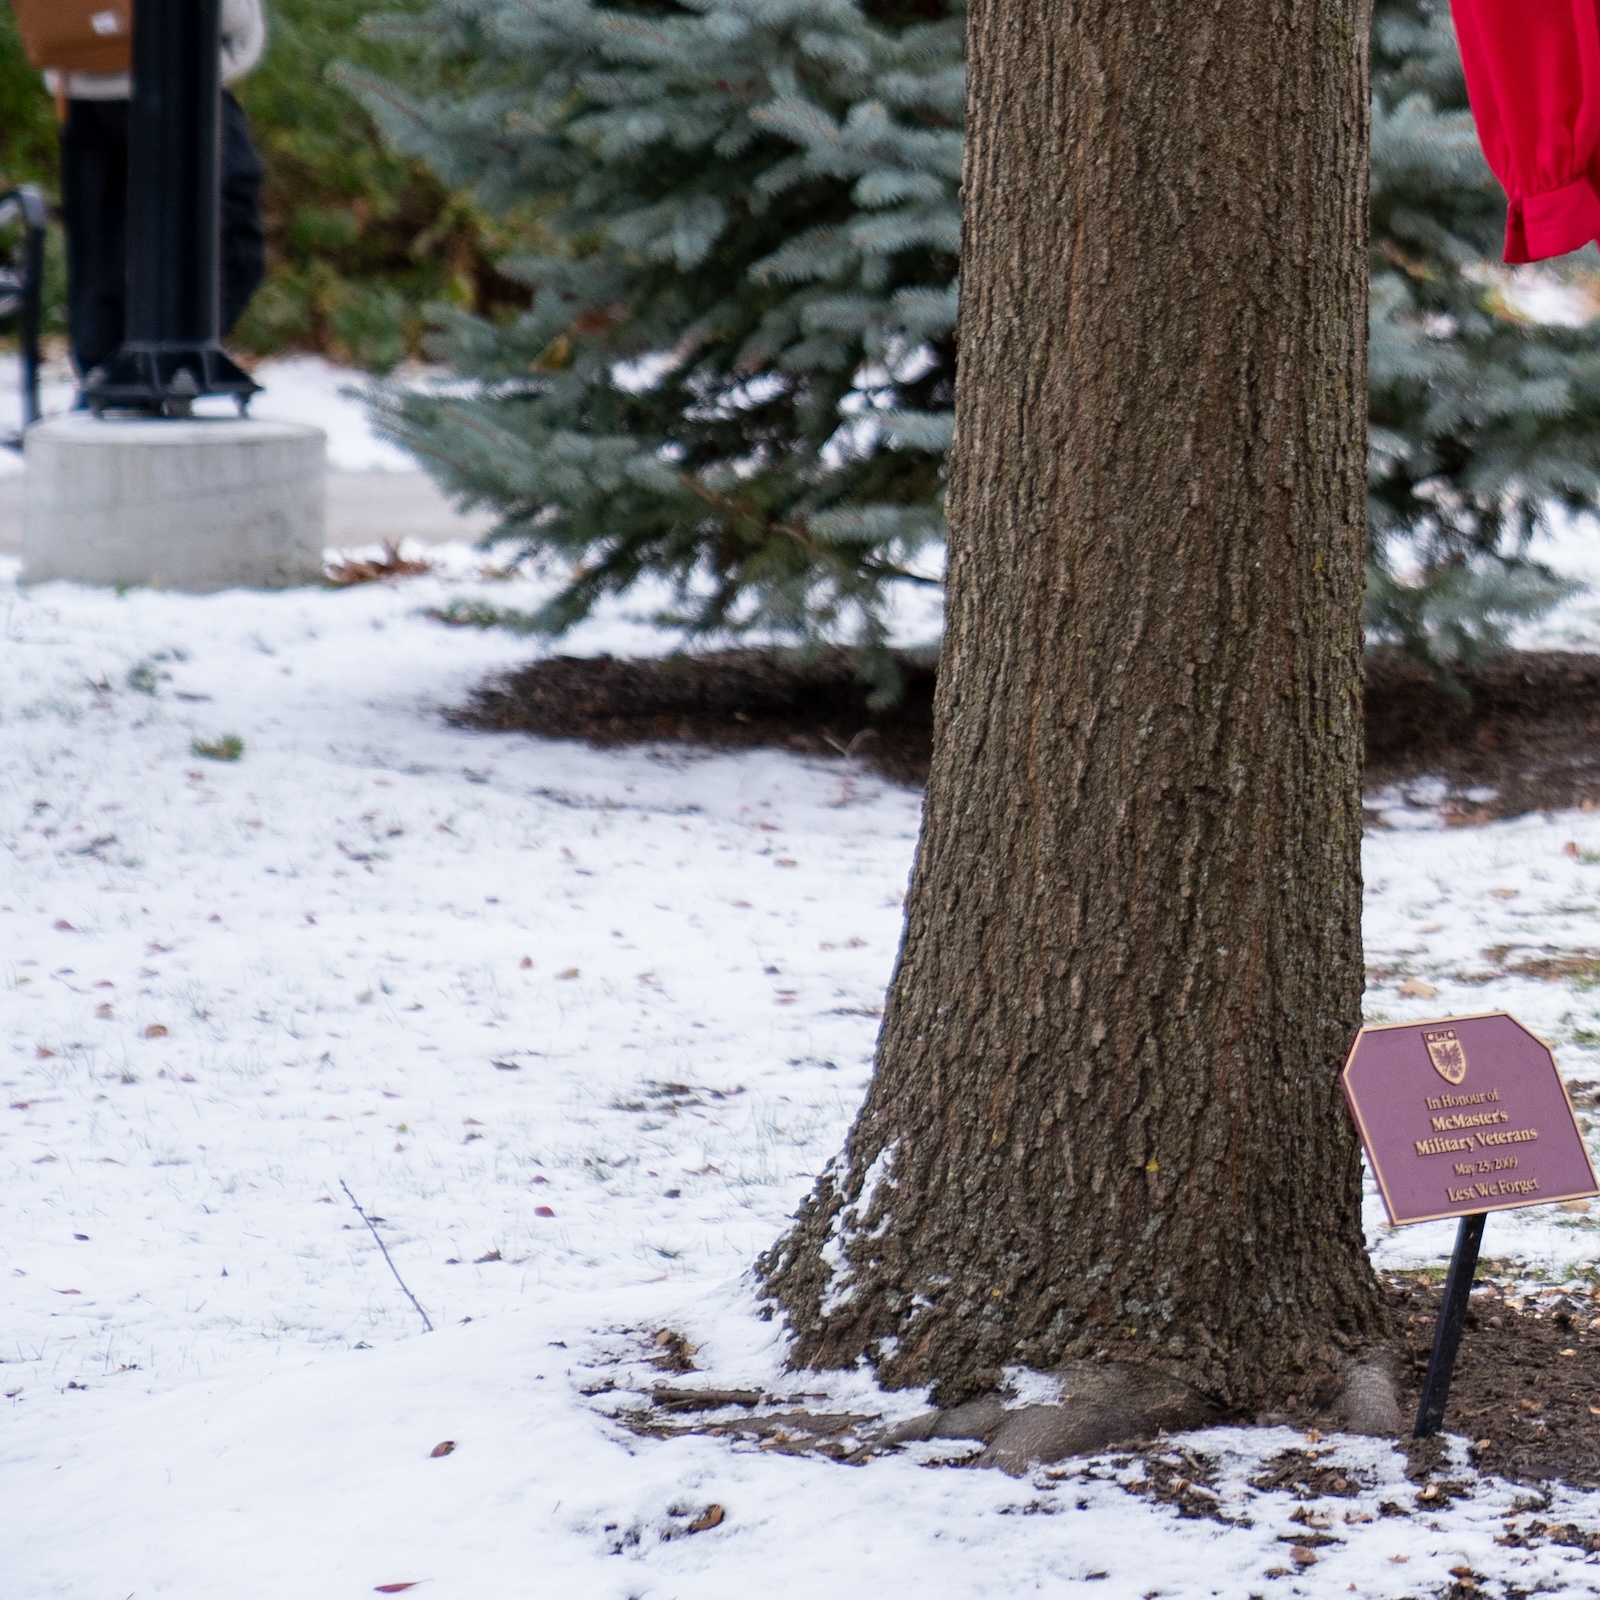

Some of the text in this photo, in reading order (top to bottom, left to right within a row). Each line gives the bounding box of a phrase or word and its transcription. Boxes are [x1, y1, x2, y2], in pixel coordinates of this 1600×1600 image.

[1426, 1088, 1500, 1111] In Honour of
[1432, 1109, 1509, 1132] McMaster's
[1415, 1127, 1538, 1156] Military Veterans
[1455, 1161, 1475, 1177] May
[1447, 1177, 1539, 1202] Lest We Forget
